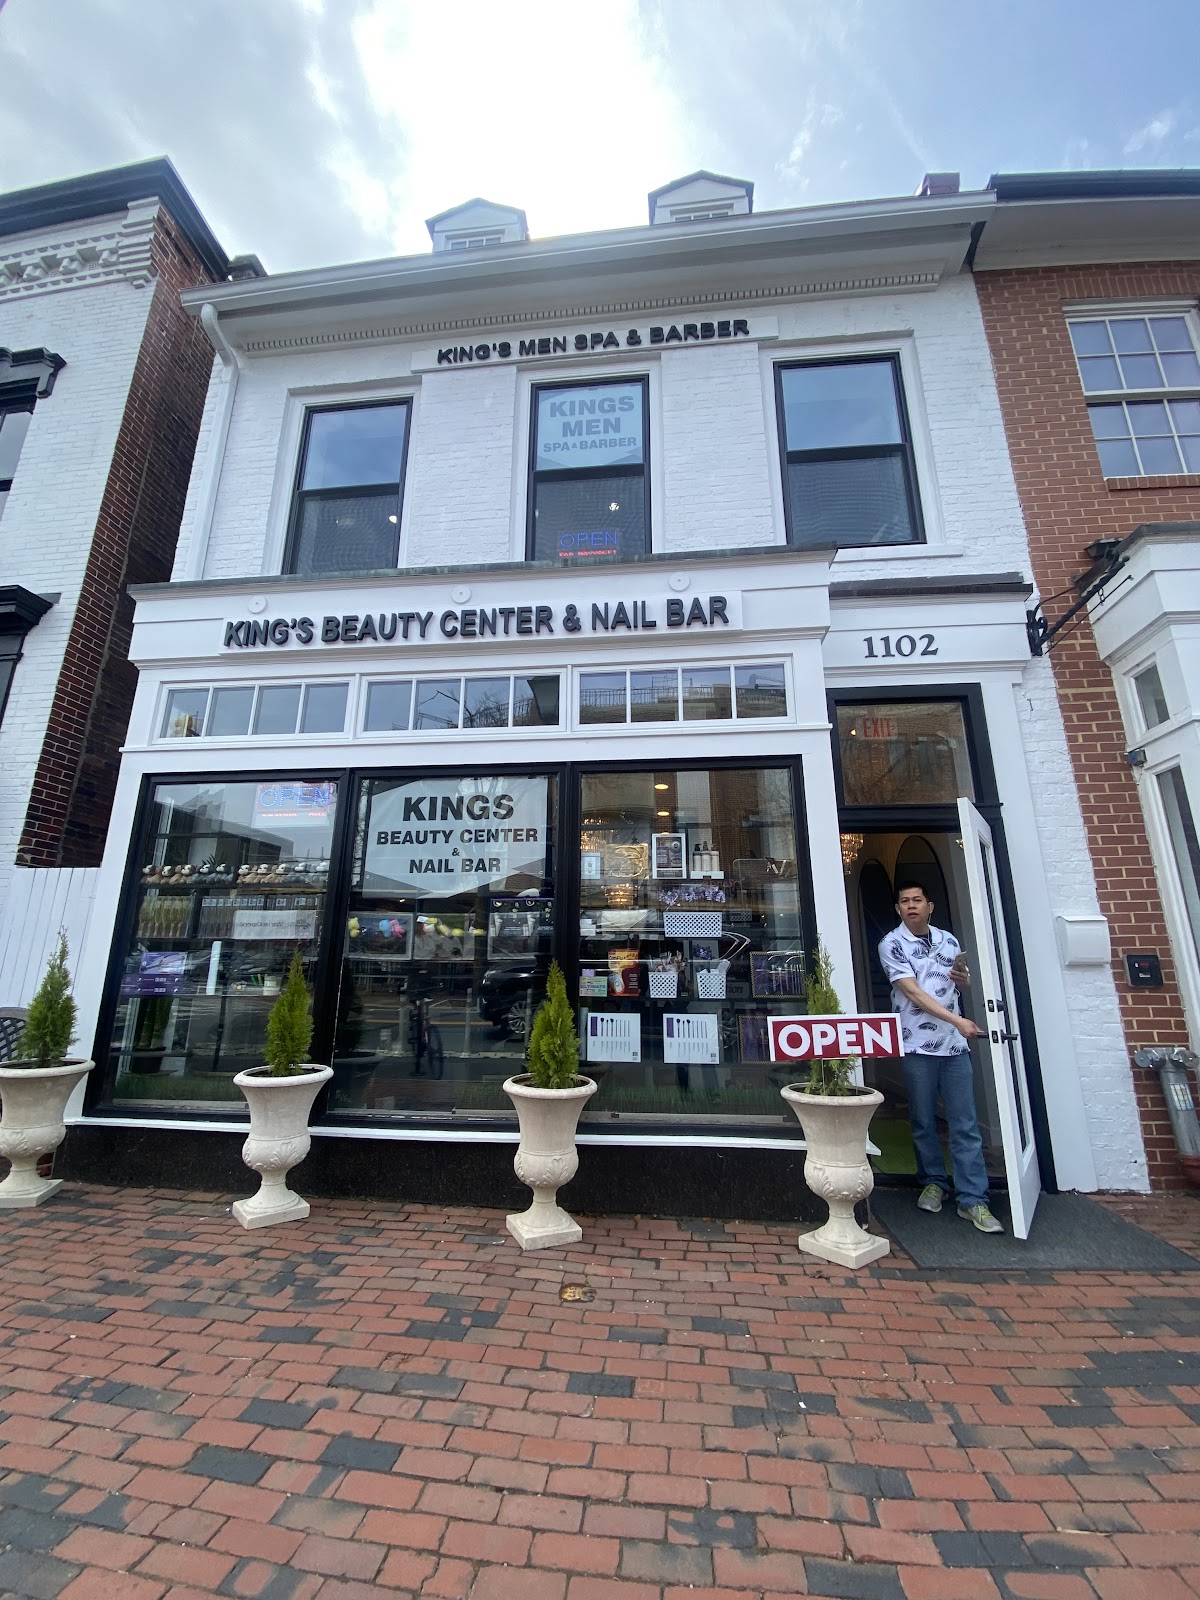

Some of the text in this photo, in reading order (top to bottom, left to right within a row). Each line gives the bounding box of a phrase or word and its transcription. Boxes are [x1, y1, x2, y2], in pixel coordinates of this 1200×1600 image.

[437, 319, 750, 365] KING'S MEN SPA & BARBER
[549, 395, 635, 418] KINGS
[562, 416, 621, 438] MEN
[560, 531, 618, 548] OPEN
[223, 595, 729, 647] KING'S BEAUTY CENTER & NAIL BAR
[863, 633, 939, 658] 1102
[863, 717, 891, 738] EXIT
[260, 786, 330, 807] OPEN
[402, 794, 515, 821] KINGS
[376, 828, 538, 845] BEAUTY CENTER
[451, 847, 460, 857] &
[409, 857, 502, 874] NAIL BAR
[777, 1021, 894, 1057] OPEN
